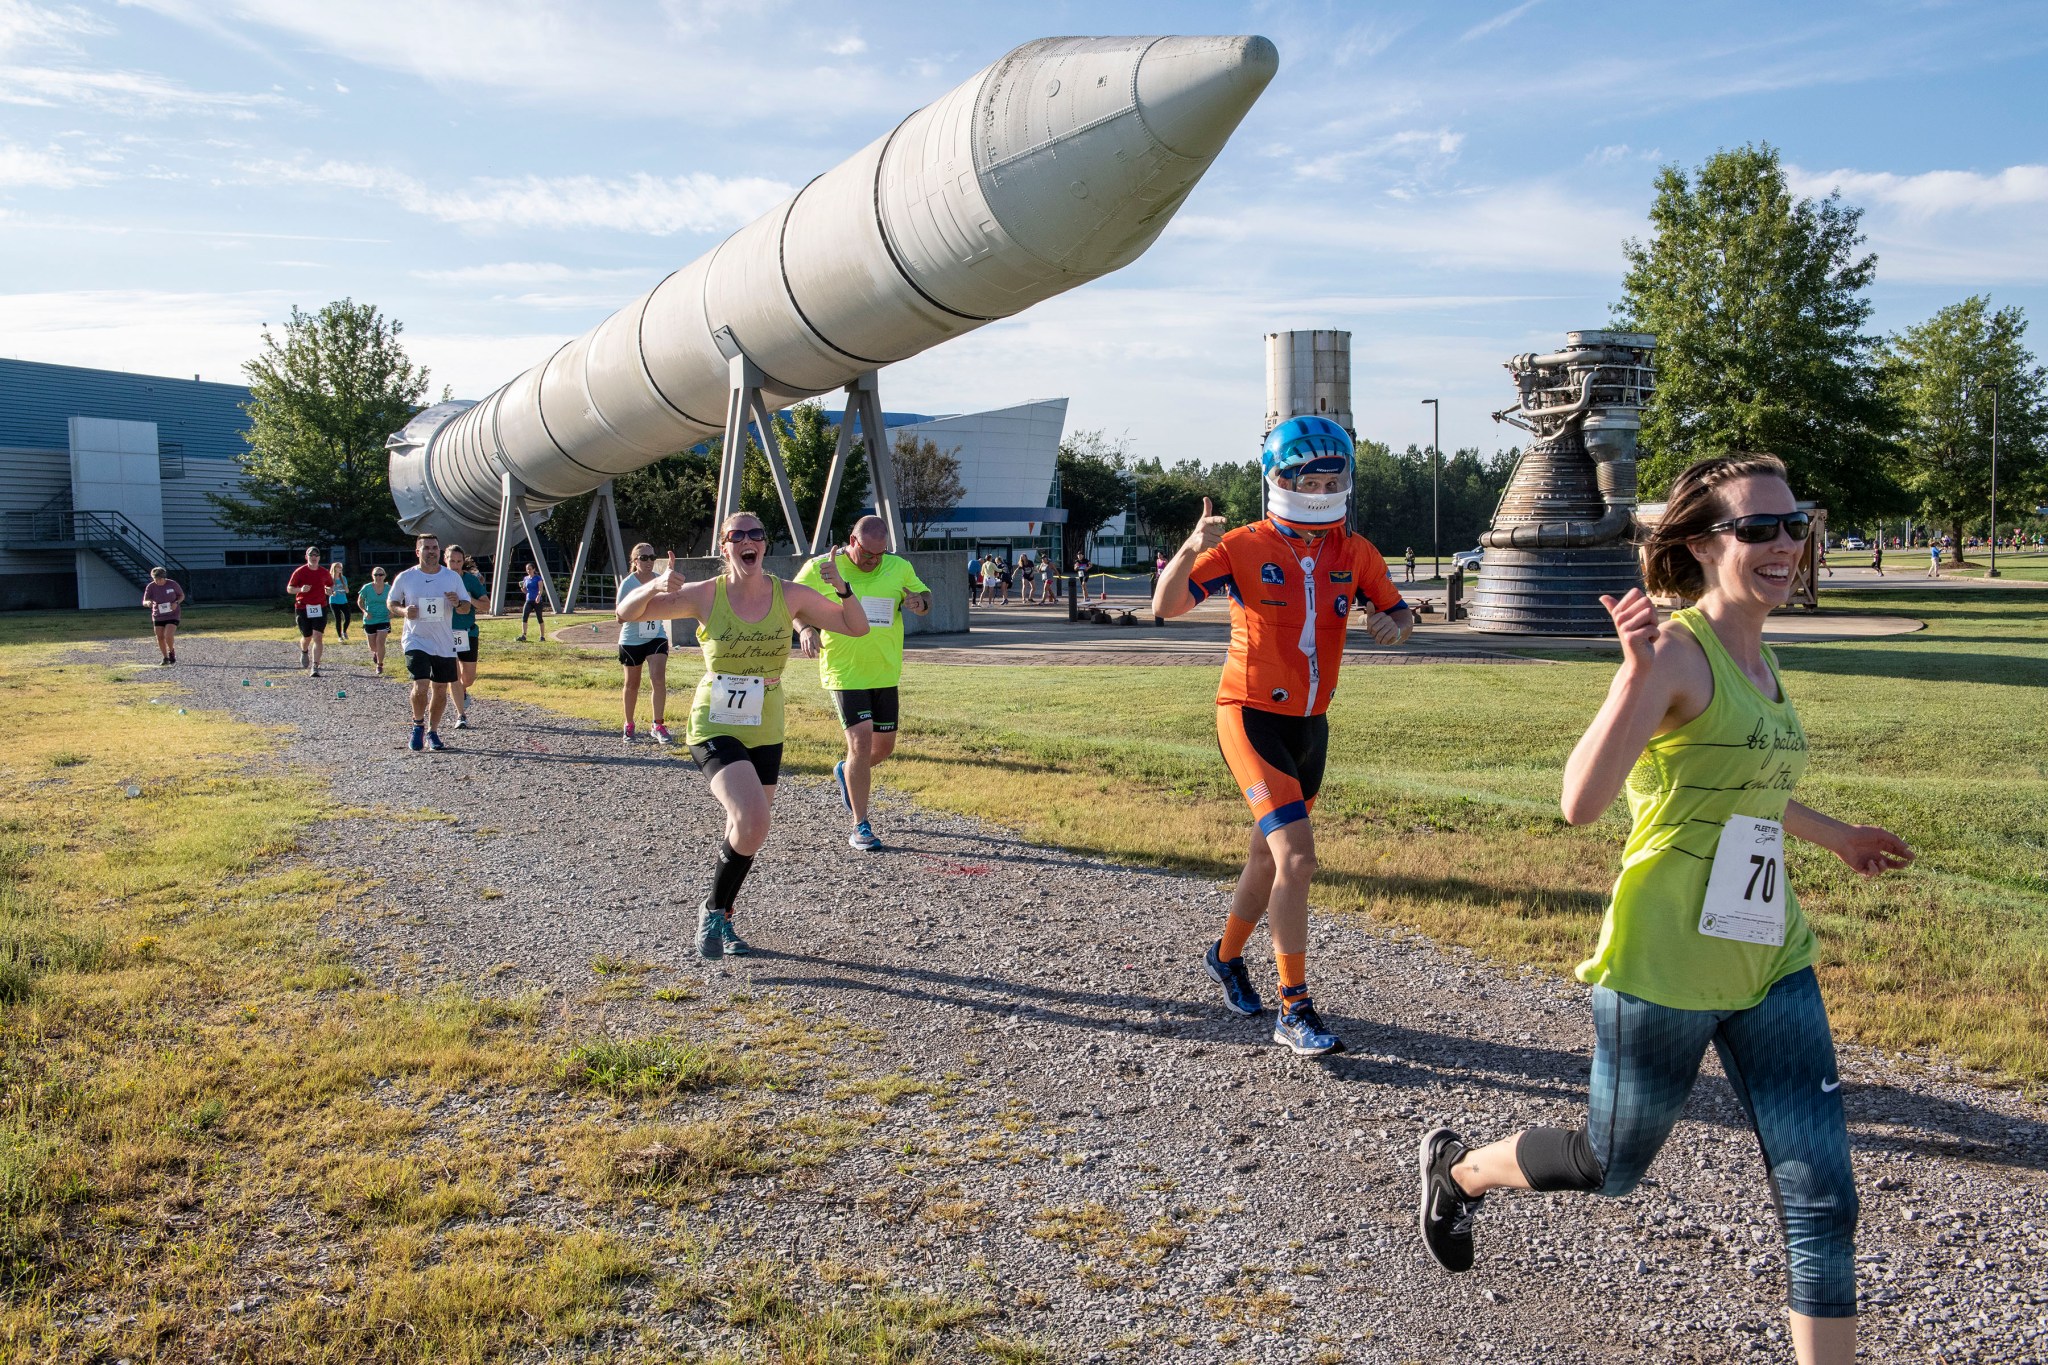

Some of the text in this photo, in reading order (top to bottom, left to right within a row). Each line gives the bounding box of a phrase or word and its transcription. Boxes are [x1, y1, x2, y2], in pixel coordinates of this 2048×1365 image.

[427, 604, 437, 614] 43
[646, 620, 656, 630] 76
[730, 627, 785, 649] patient
[723, 644, 787, 659] and trust
[727, 689, 747, 709] 77
[1747, 716, 1770, 750] be
[1754, 823, 1771, 834] FLEET
[1744, 854, 1776, 904] 70
